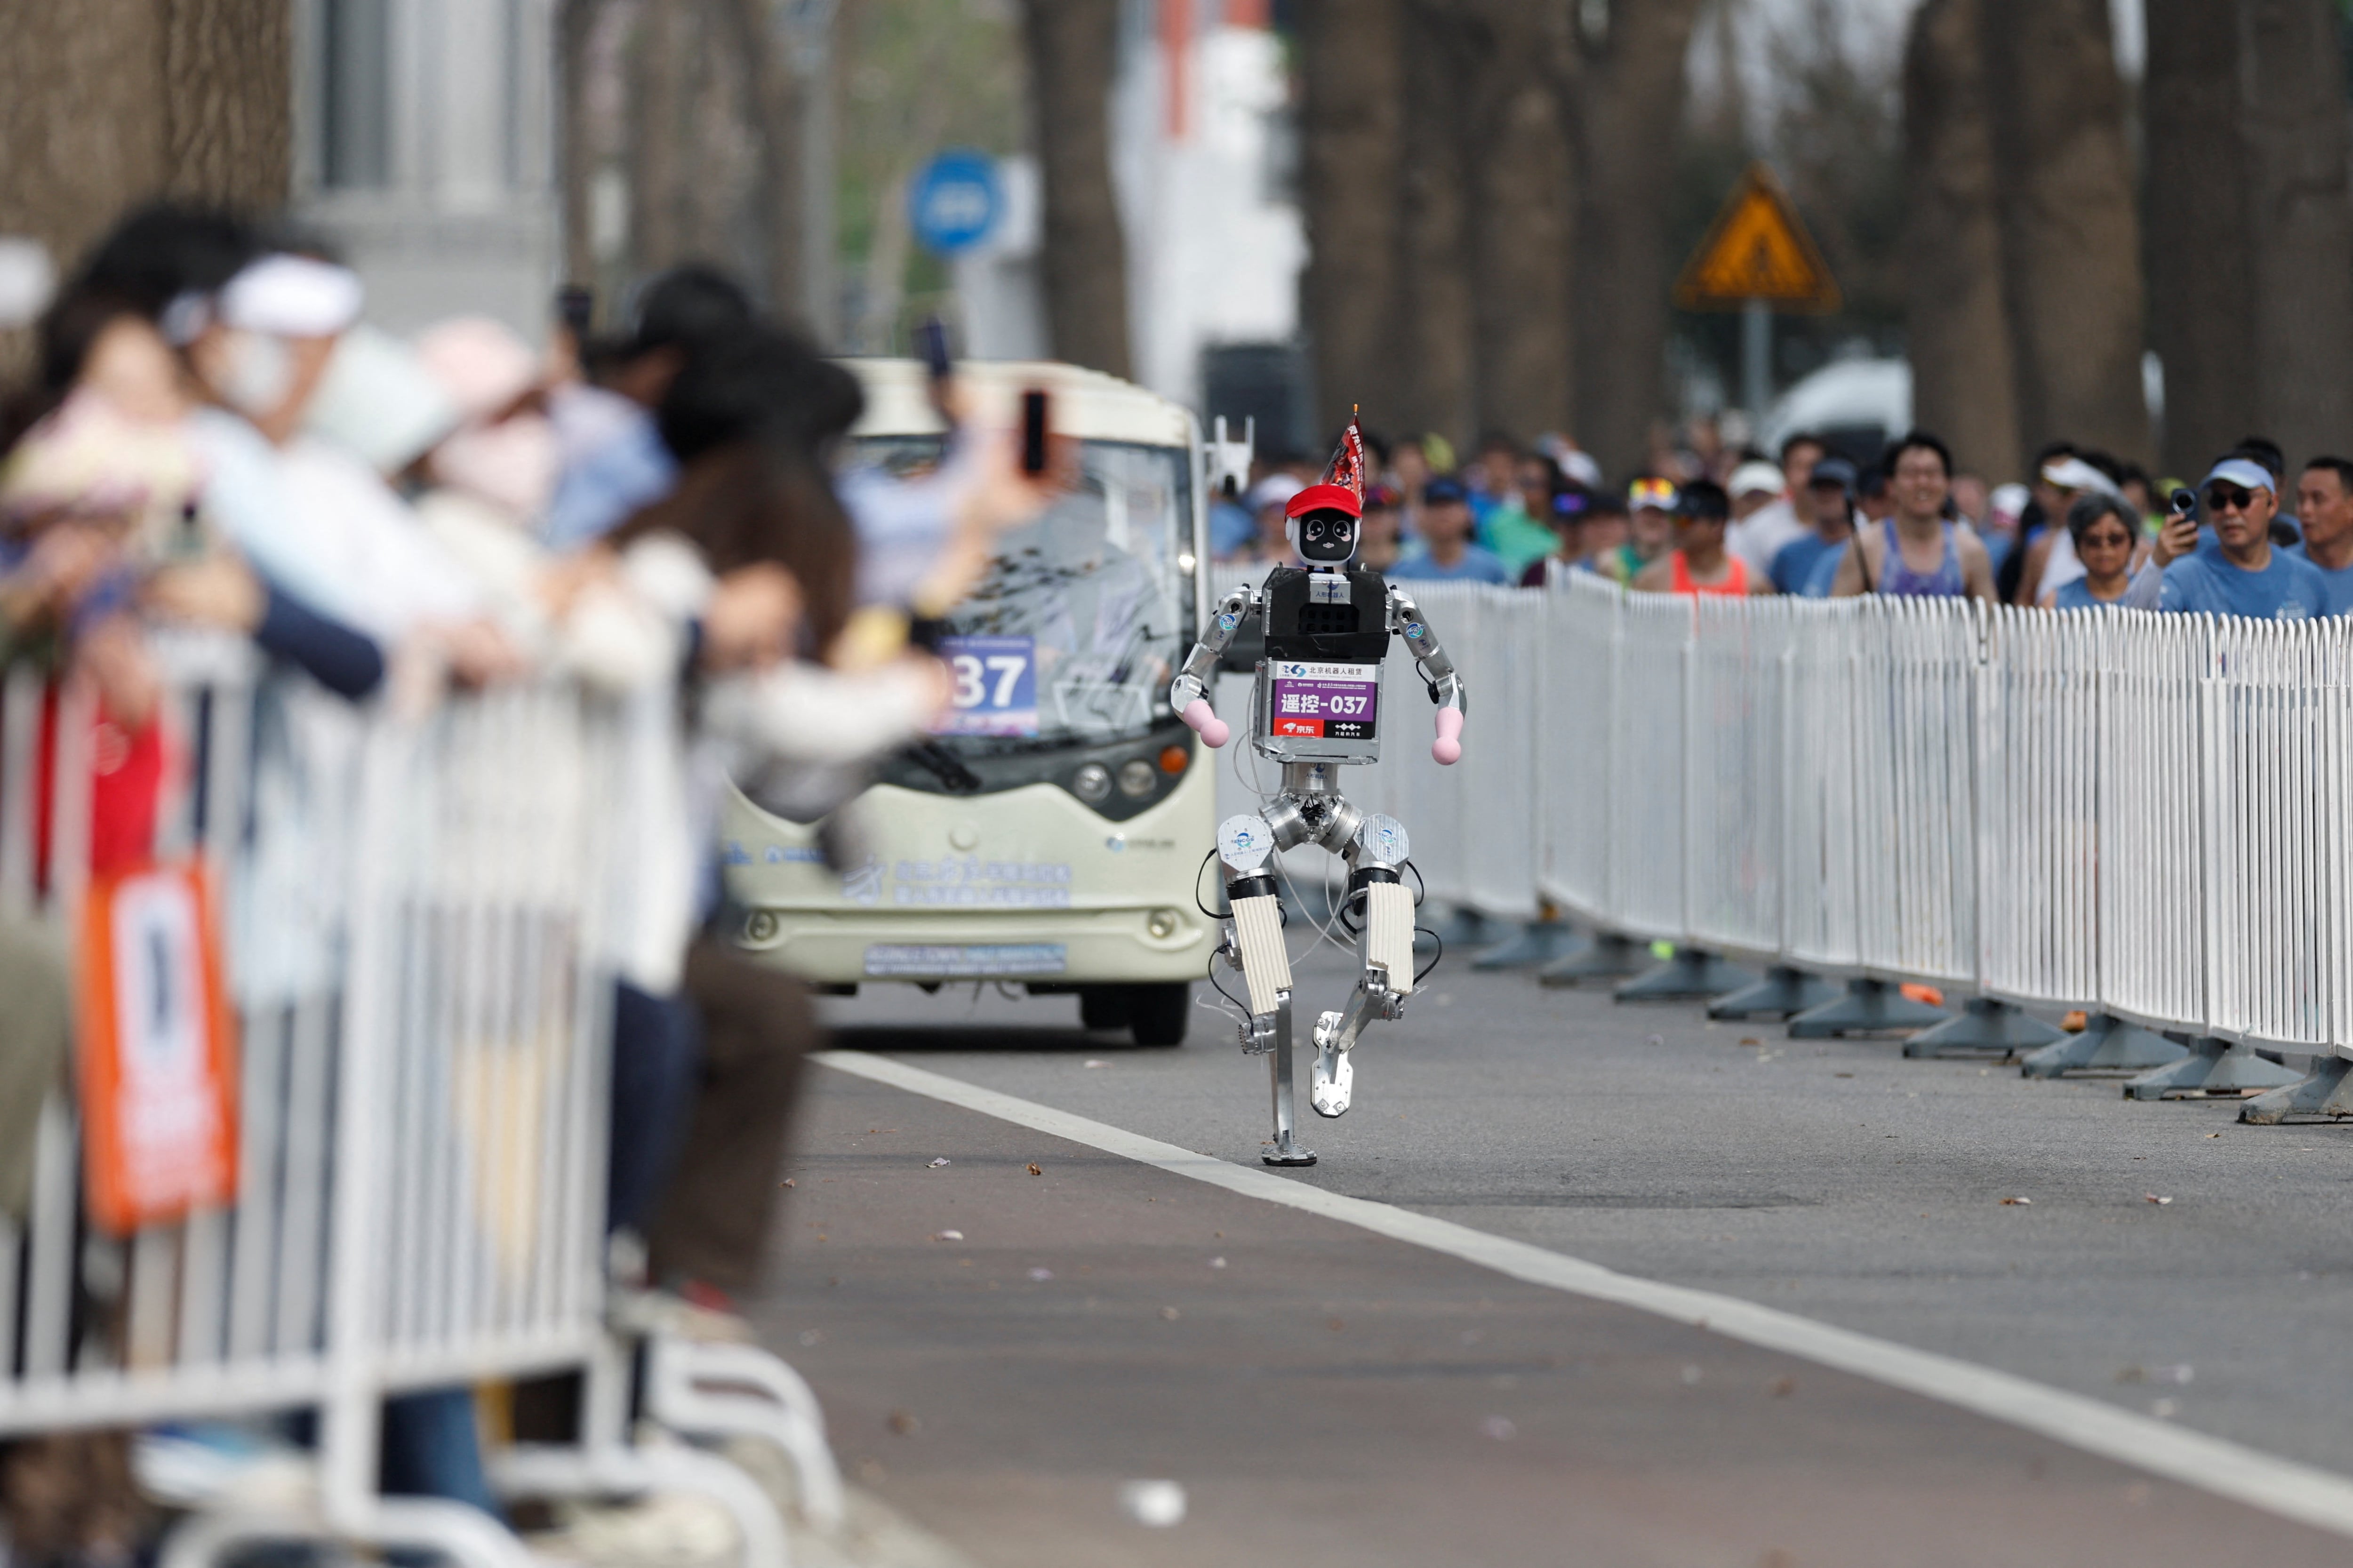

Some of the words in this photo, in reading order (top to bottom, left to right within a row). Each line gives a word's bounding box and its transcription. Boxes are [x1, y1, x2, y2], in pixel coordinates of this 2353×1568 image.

[1309, 666, 1363, 675] 北京机器人租赁
[1281, 694, 1367, 714] 遥控-037
[1296, 725, 1315, 734] 京东
[1378, 832, 1397, 841] ENCOS
